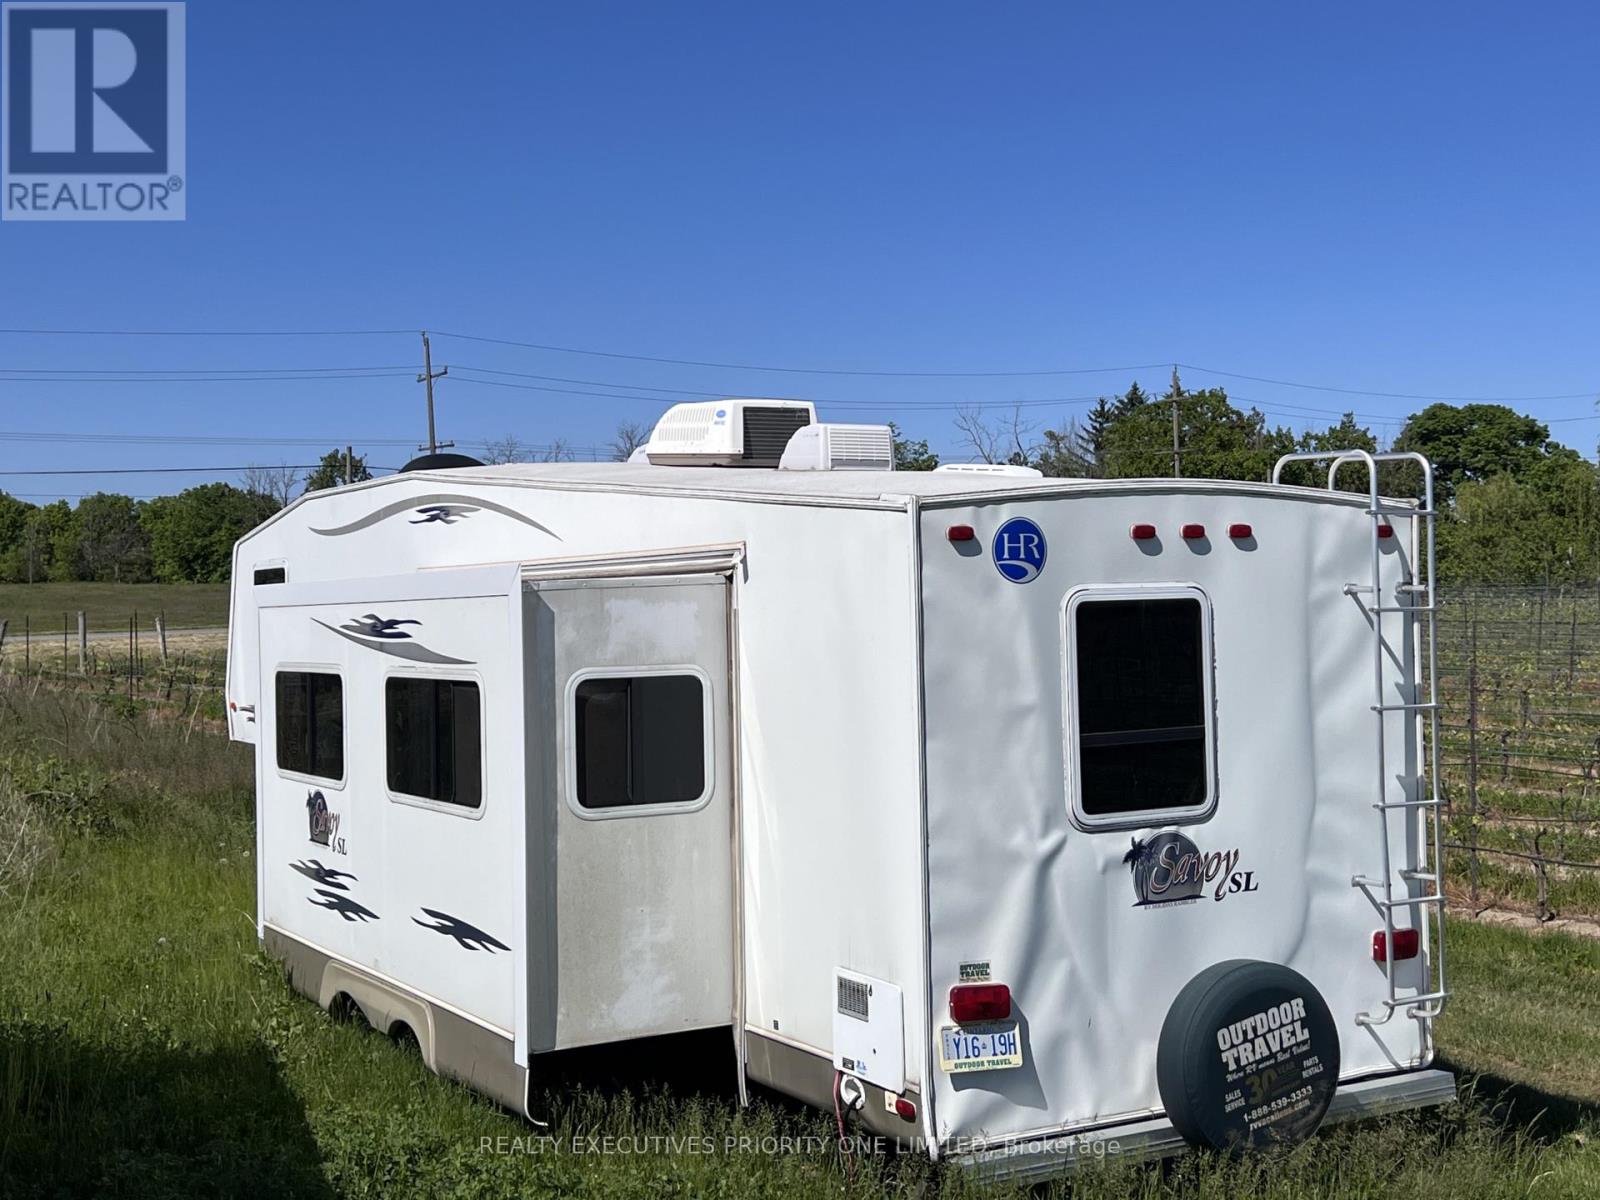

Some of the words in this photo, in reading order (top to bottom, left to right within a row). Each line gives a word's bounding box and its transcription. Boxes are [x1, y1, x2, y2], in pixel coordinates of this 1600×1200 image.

[1002, 532, 1040, 559] HR
[313, 798, 340, 852] Savoy
[337, 836, 347, 855] SL
[1150, 841, 1240, 901] Savoy
[1228, 871, 1259, 893] SL
[960, 963, 990, 971] OUTDOOR
[960, 970, 990, 978] TRAVEL
[1216, 997, 1306, 1051] OUTDOOR
[953, 1036, 981, 1060] Y16
[991, 1032, 1017, 1057] 19H
[1221, 1020, 1310, 1072] TRAVEL
[954, 1061, 986, 1069] OUTDOOR
[987, 1058, 1012, 1067] TRAVEL
[1302, 1063, 1324, 1079] RENTALS
[1303, 1055, 1320, 1069] PARTS
[1224, 1096, 1246, 1113] SERVICE
[1225, 1089, 1242, 1103] SALES
[1243, 1085, 1313, 1123] 1-888-539-3333
